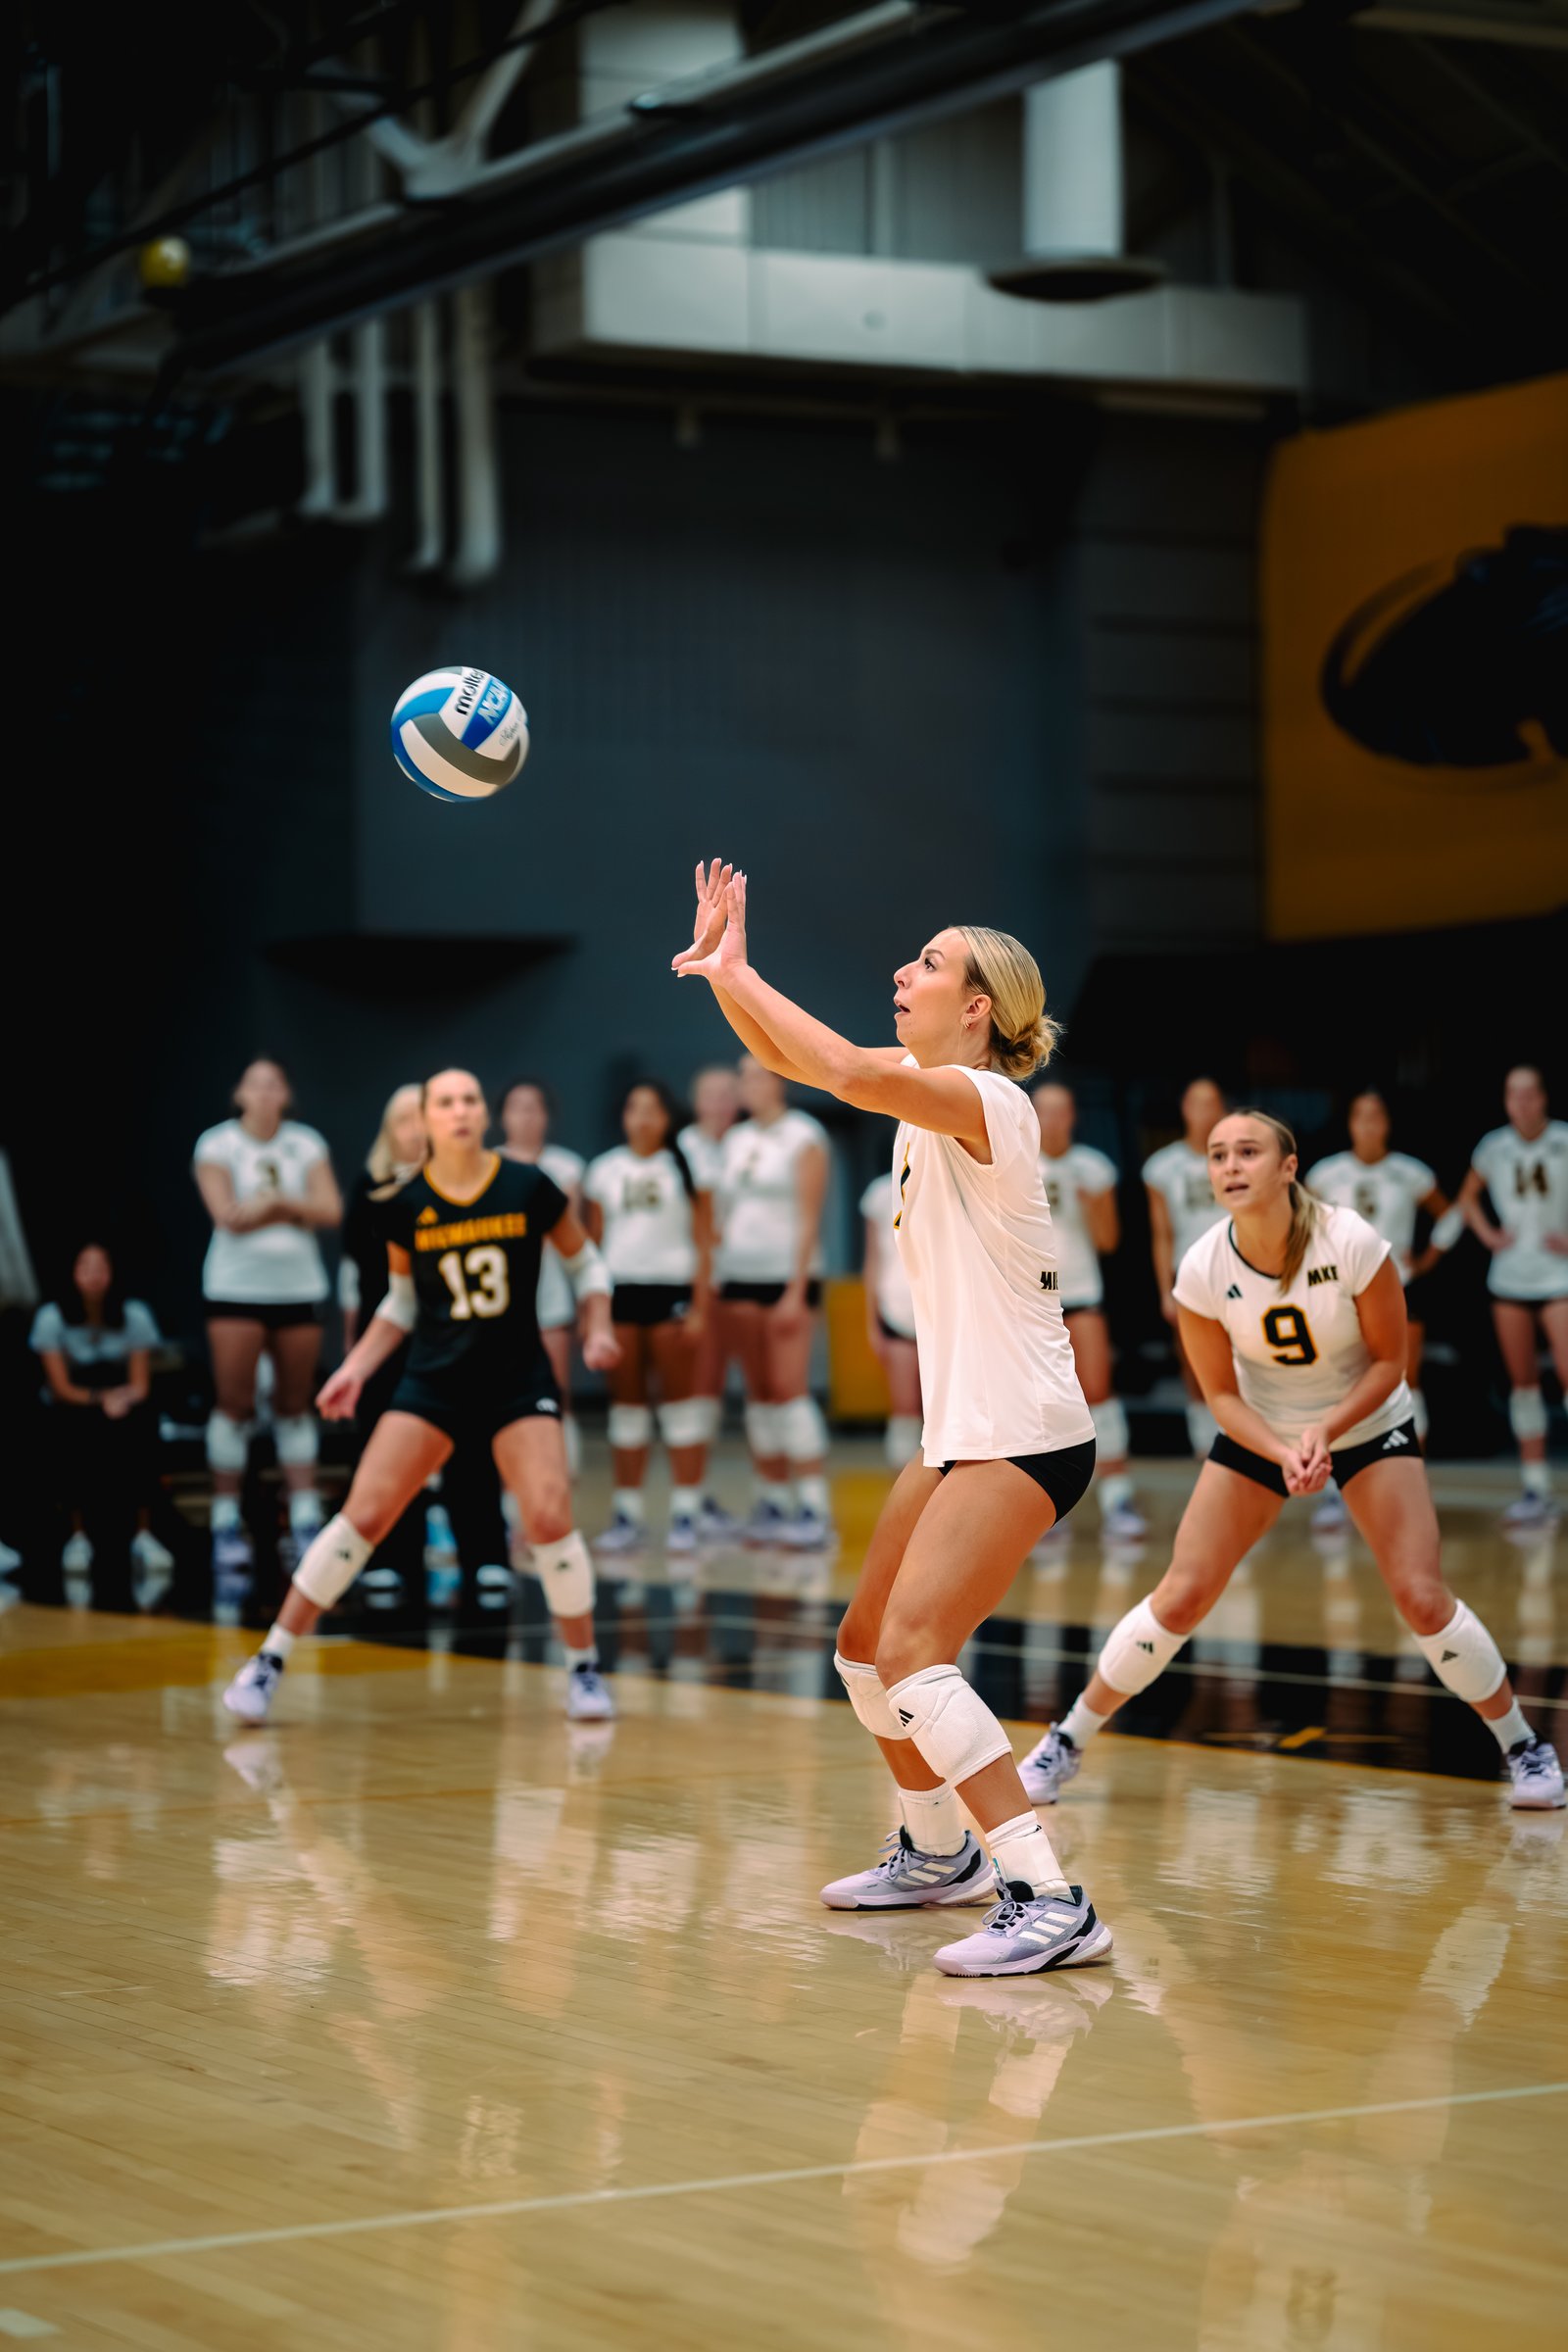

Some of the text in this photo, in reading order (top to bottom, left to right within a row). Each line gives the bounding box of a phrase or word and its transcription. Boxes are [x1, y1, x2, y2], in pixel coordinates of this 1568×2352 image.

[477, 678, 510, 726] NCAA
[438, 1244, 511, 1320] 13
[1307, 1265, 1340, 1287] MKE
[1261, 1303, 1319, 1367] 9
